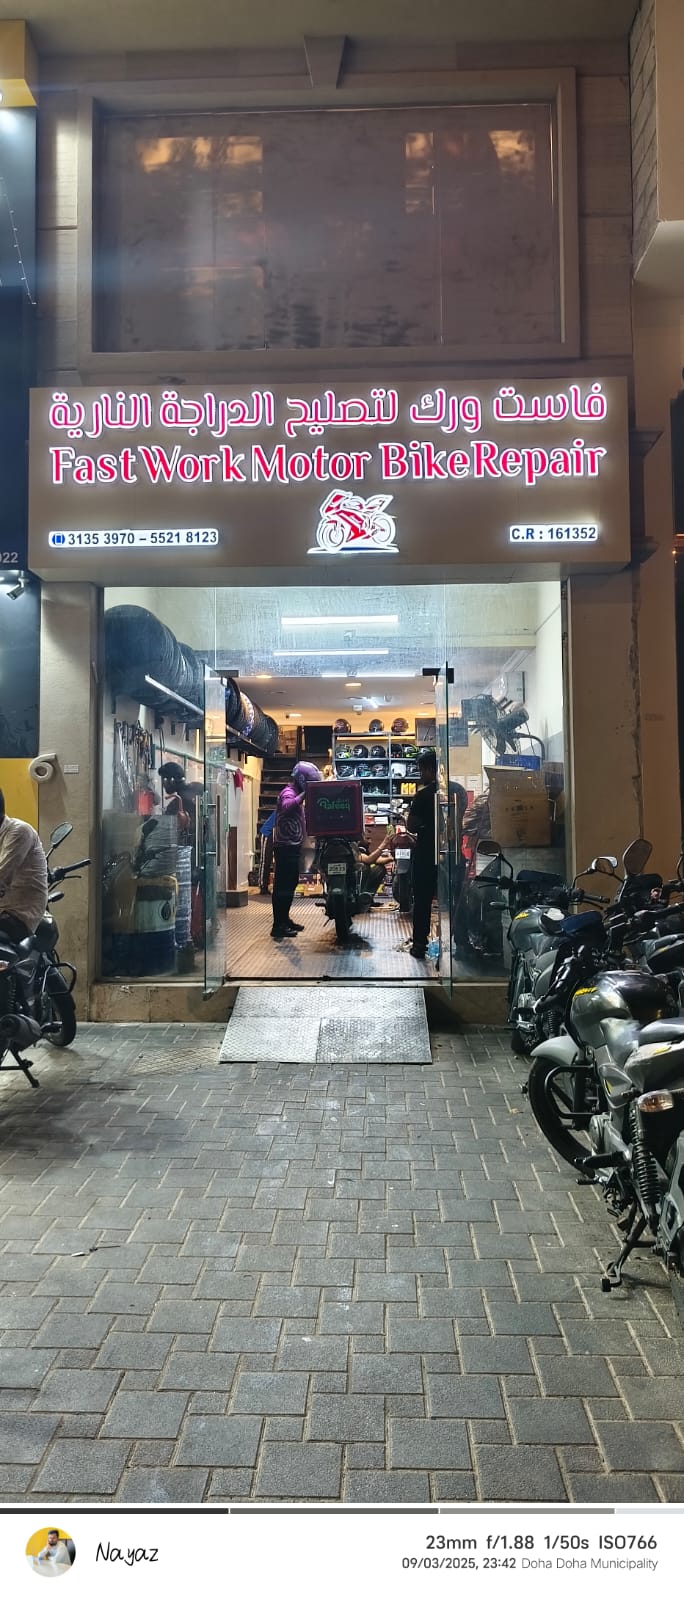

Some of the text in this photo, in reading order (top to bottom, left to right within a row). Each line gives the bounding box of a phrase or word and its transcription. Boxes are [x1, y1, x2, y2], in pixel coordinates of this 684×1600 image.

[49, 383, 607, 438] فاست ورك لتصليح الدراجة النارية
[49, 438, 607, 486] Fast Work Motor Bike Repair
[68, 533, 99, 545] 3135
[104, 532, 135, 545] 3970
[150, 532, 181, 544] 5521
[186, 531, 217, 543] 8123
[511, 528, 535, 540] C.R
[547, 527, 596, 540] 161352
[0, 551, 19, 564] 22
